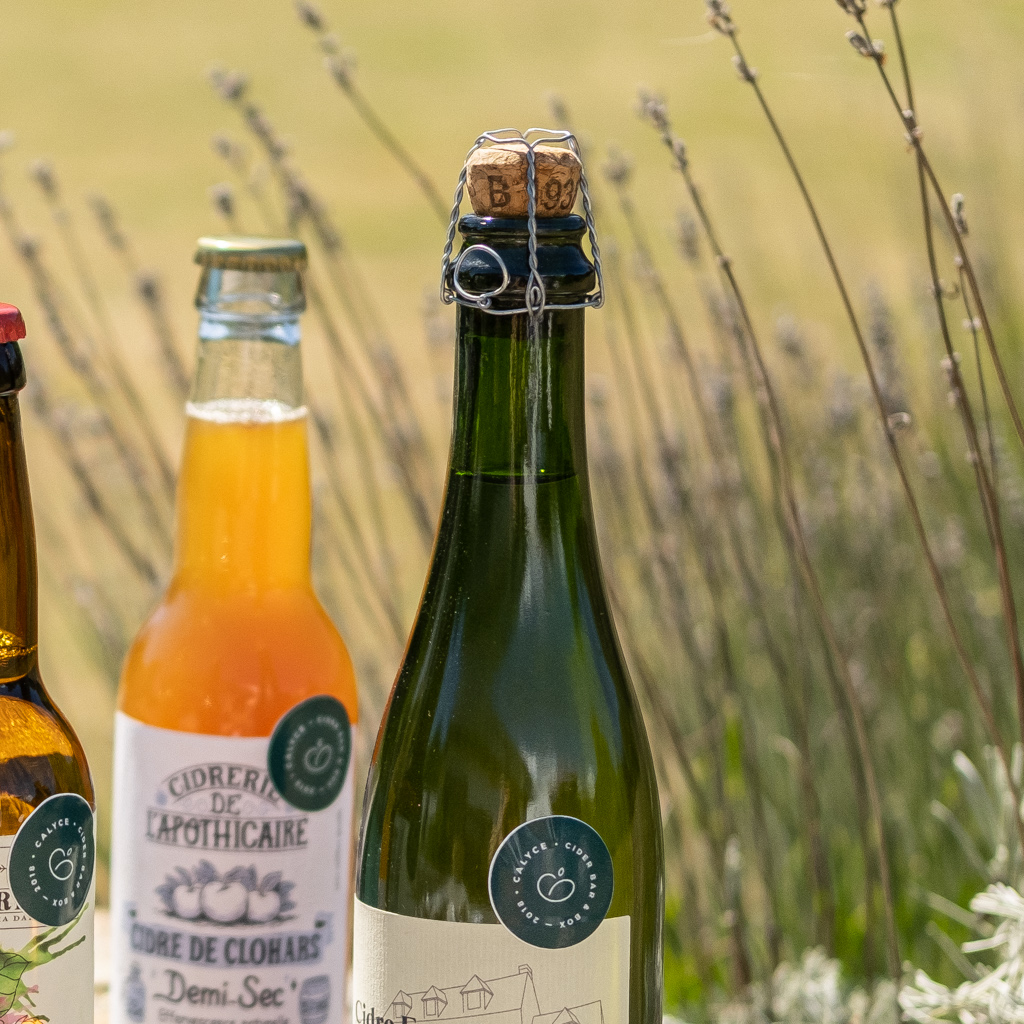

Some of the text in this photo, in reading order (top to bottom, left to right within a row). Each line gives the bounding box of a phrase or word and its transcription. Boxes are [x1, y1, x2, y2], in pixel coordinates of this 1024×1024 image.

[211, 792, 242, 815] DE
[35, 818, 69, 849] CALYCE
[513, 842, 547, 883] CALYCE
[565, 842, 593, 868] CIDER
[29, 865, 41, 893] 2018
[588, 873, 597, 899] BAR
[52, 897, 69, 907] BOX
[517, 901, 540, 924] 2018
[559, 913, 581, 929] BOX
[131, 922, 321, 965] CIDRE DE CLOHARS
[153, 968, 285, 1008] Demi Sec
